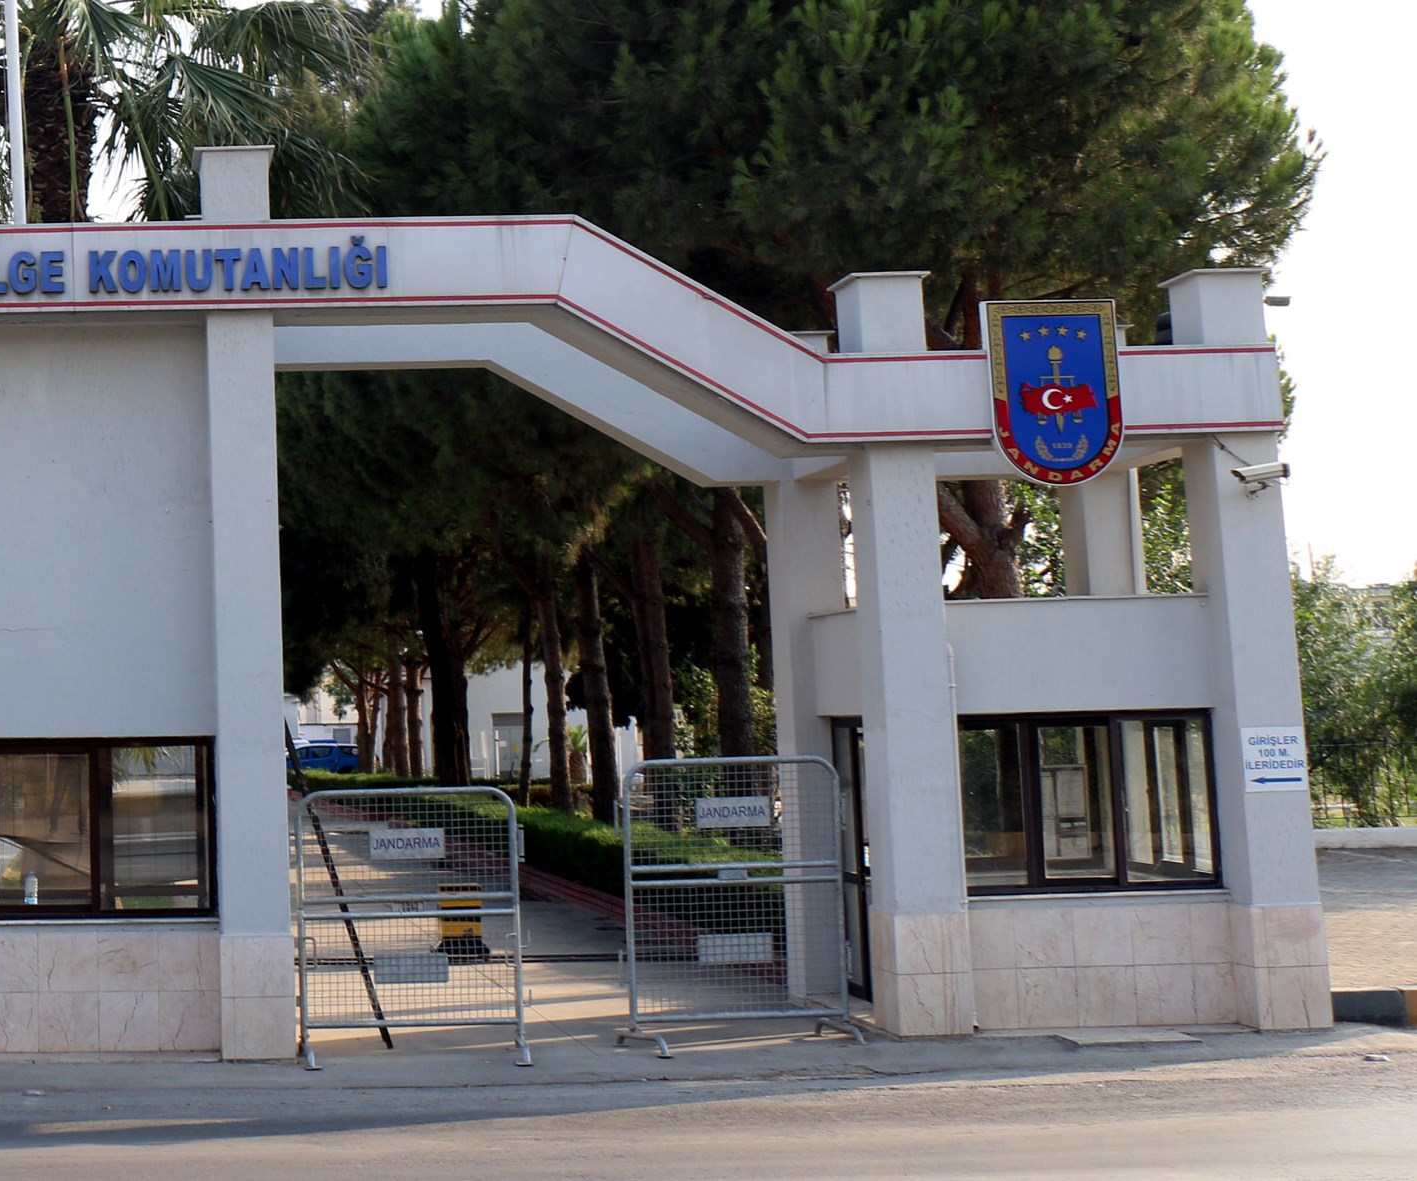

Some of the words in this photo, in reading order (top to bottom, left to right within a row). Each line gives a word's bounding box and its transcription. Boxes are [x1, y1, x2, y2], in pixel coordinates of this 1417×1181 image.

[88, 235, 388, 294] KOMUTANLIĞI
[998, 421, 1121, 481] JANDARMA
[1248, 735, 1298, 746] GİRİŞLER
[1258, 748, 1276, 757] 100
[1278, 748, 1290, 757] M.
[1245, 758, 1304, 770] İLERİDEDİR
[699, 805, 766, 818] JANDARMA
[373, 837, 441, 850] JANDARMA
